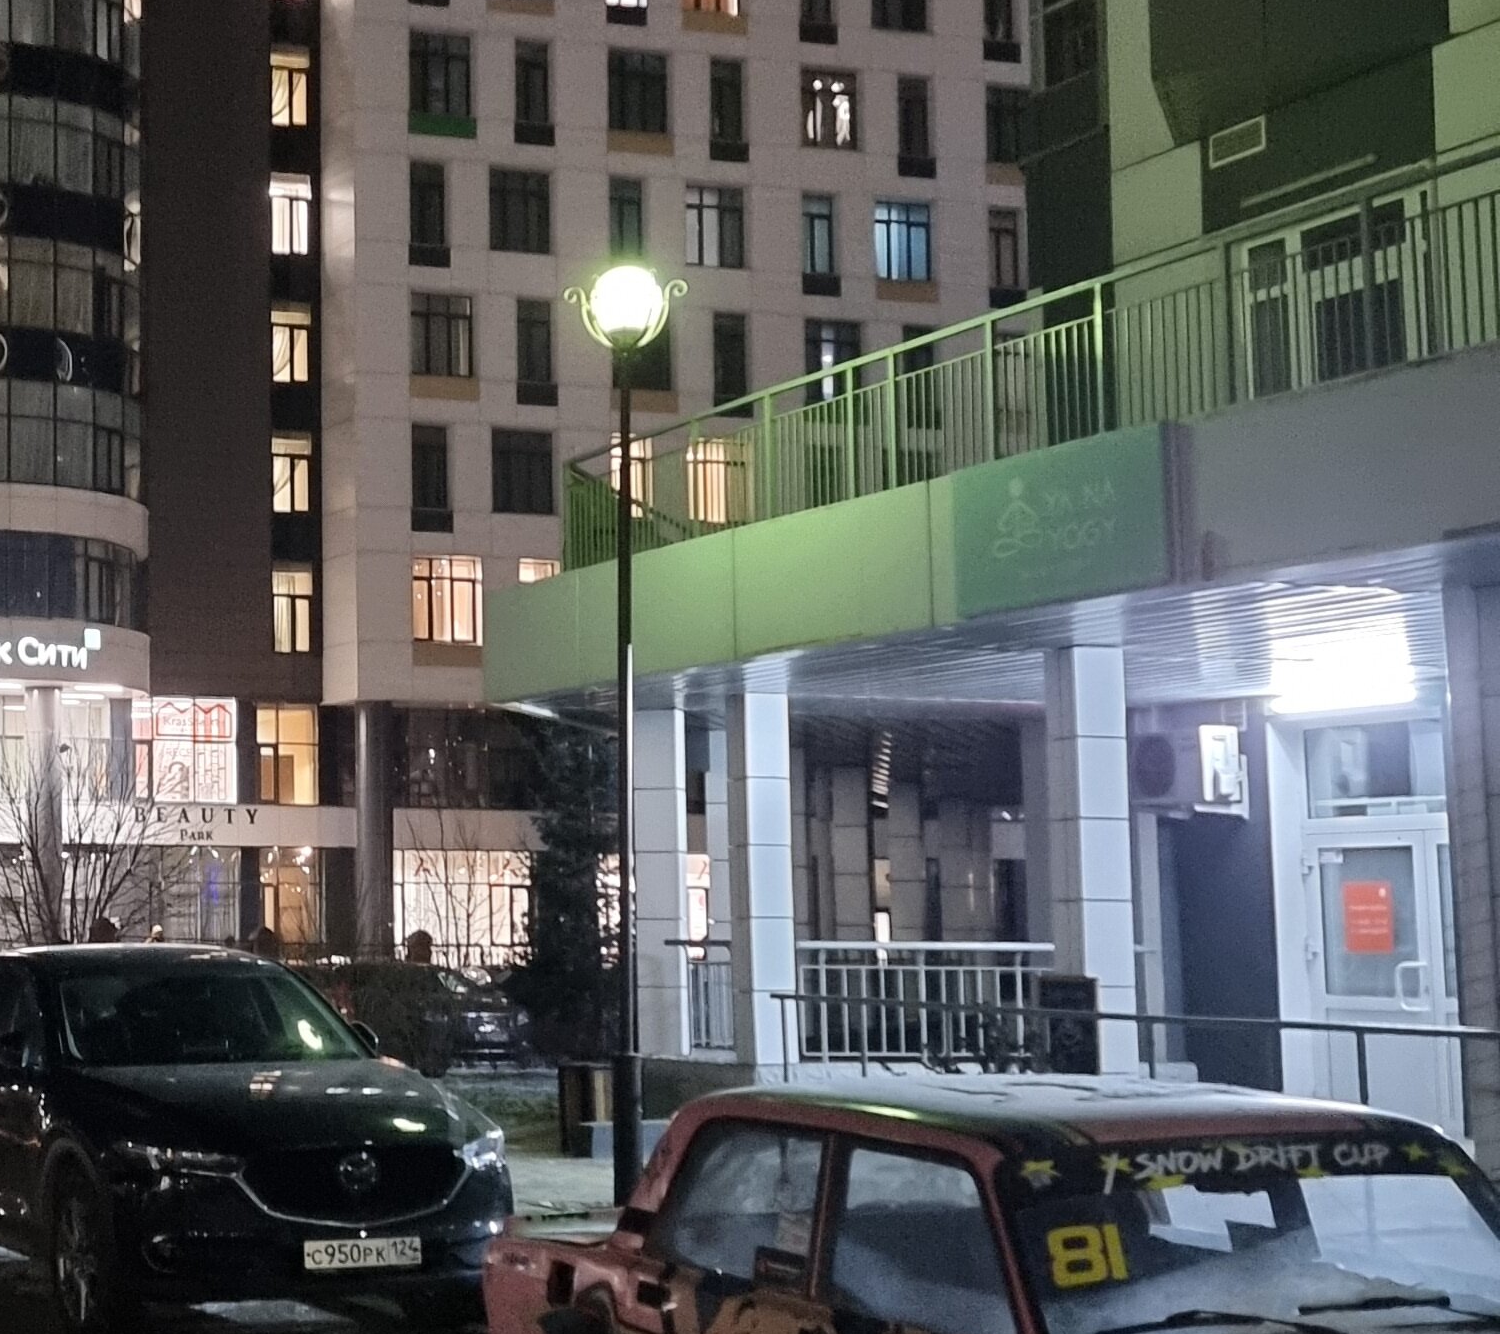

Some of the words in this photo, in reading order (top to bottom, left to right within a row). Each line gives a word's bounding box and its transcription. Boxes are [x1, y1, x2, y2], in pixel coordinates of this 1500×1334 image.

[17, 636, 88, 670] Сити
[135, 807, 258, 824] BEAUTY
[1135, 1146, 1223, 1180] SNOW
[1235, 1143, 1319, 1171] DRIFT
[1334, 1143, 1389, 1167] CUP
[1047, 1223, 1129, 1289] 81
